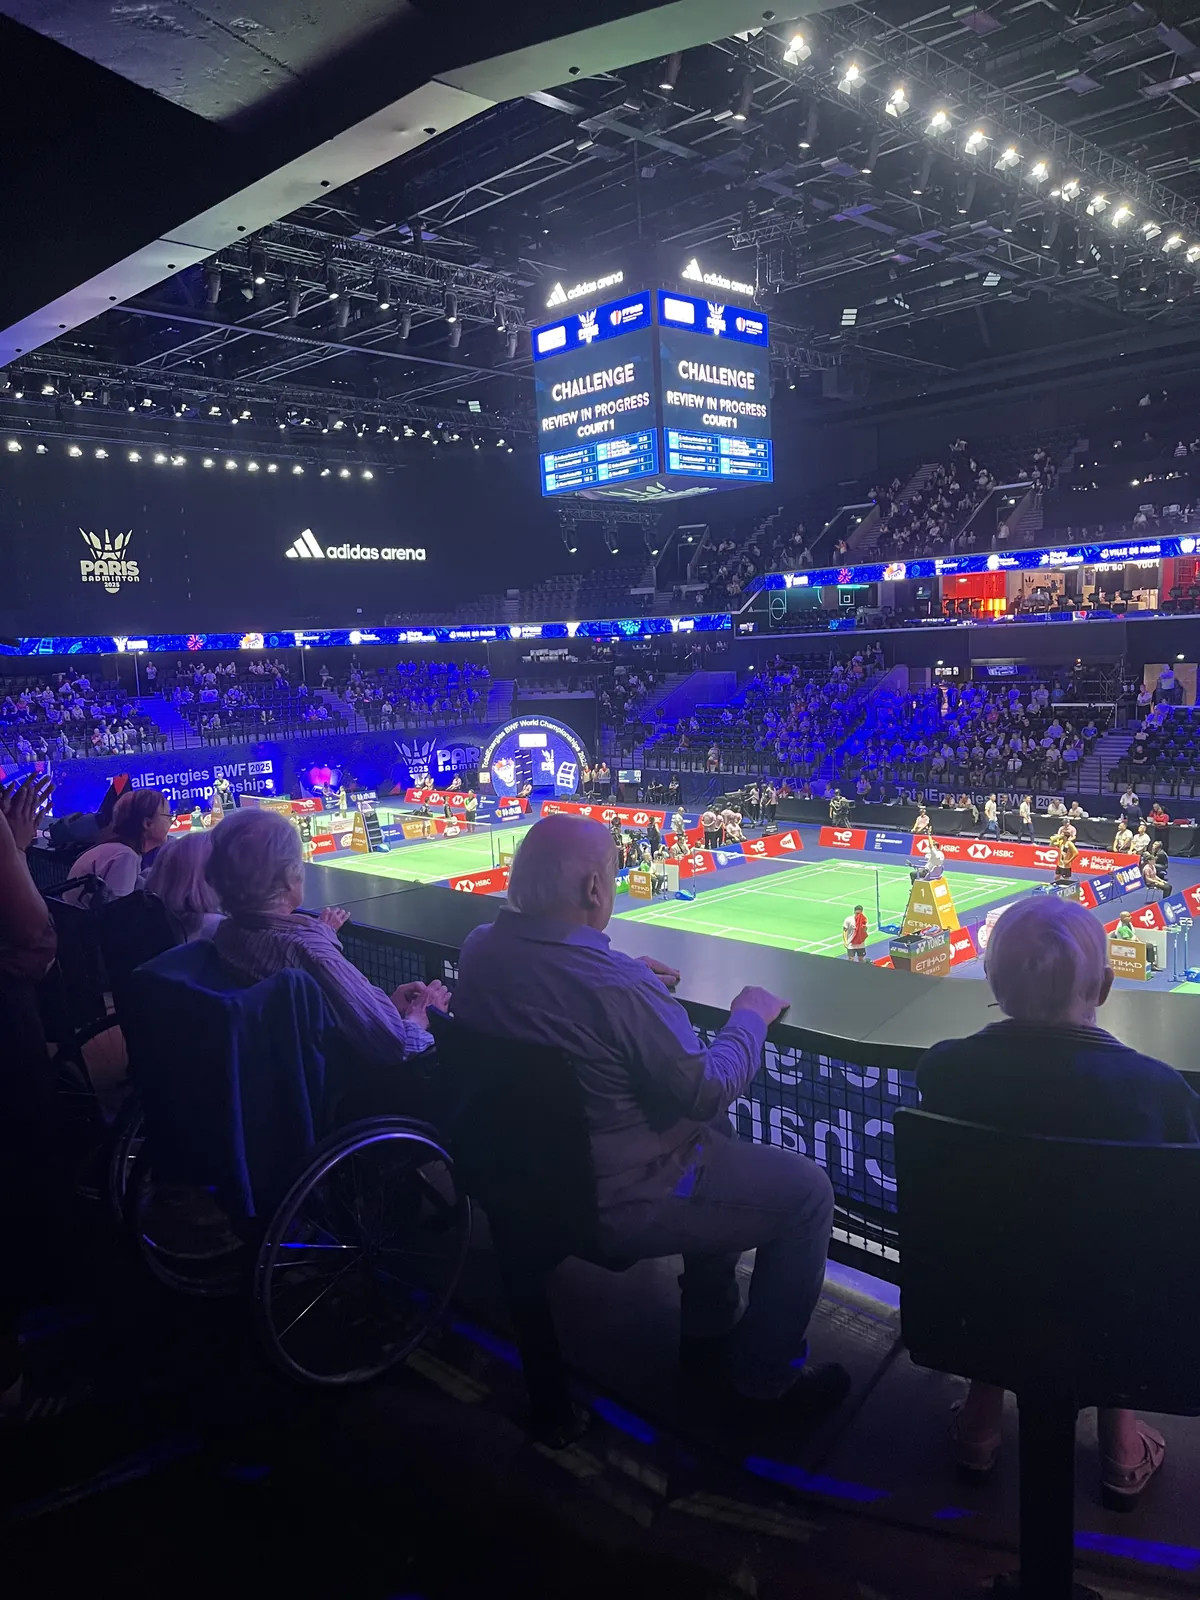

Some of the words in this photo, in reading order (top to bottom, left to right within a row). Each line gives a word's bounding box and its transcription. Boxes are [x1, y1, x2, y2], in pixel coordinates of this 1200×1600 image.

[567, 281, 597, 300] adidas
[597, 271, 624, 289] arena
[704, 273, 730, 290] adidas
[731, 281, 754, 296] arena
[552, 362, 635, 402] CHALLENGE
[678, 360, 755, 390] CHALLENGE
[541, 410, 578, 432] REVIEW
[581, 406, 592, 422] IN
[594, 392, 650, 418] PROGRESS
[666, 390, 704, 409] REVIEW
[706, 396, 717, 411] IN
[719, 398, 767, 418] PROGRESS
[577, 420, 608, 438] COURT
[608, 418, 615, 430] 1
[702, 413, 732, 428] COURT
[732, 417, 737, 429] 1
[326, 543, 380, 560] adidas
[380, 547, 426, 561] arena
[1109, 547, 1128, 558] VILLE
[1129, 547, 1139, 555] DE
[1140, 545, 1161, 554] PARIS
[80, 560, 140, 576] PARIS
[481, 731, 506, 768] TotalEnergies
[504, 722, 519, 734] BWF
[519, 719, 539, 727] World
[539, 720, 581, 752] Championships
[436, 746, 480, 766] PAR
[106, 769, 210, 789] TalEnergies
[213, 763, 246, 779] BWF
[249, 761, 272, 775] 2025
[408, 765, 429, 774] 2025
[317, 840, 333, 848] HSBC
[940, 844, 961, 853] HSBC
[992, 850, 1015, 859] HSBC
[1091, 855, 1115, 865] Région
[474, 878, 492, 888] HSBC
[920, 888, 925, 898] 1
[927, 934, 946, 950] YONEX
[954, 938, 971, 952] HSBC
[915, 952, 947, 972] ETIHAD
